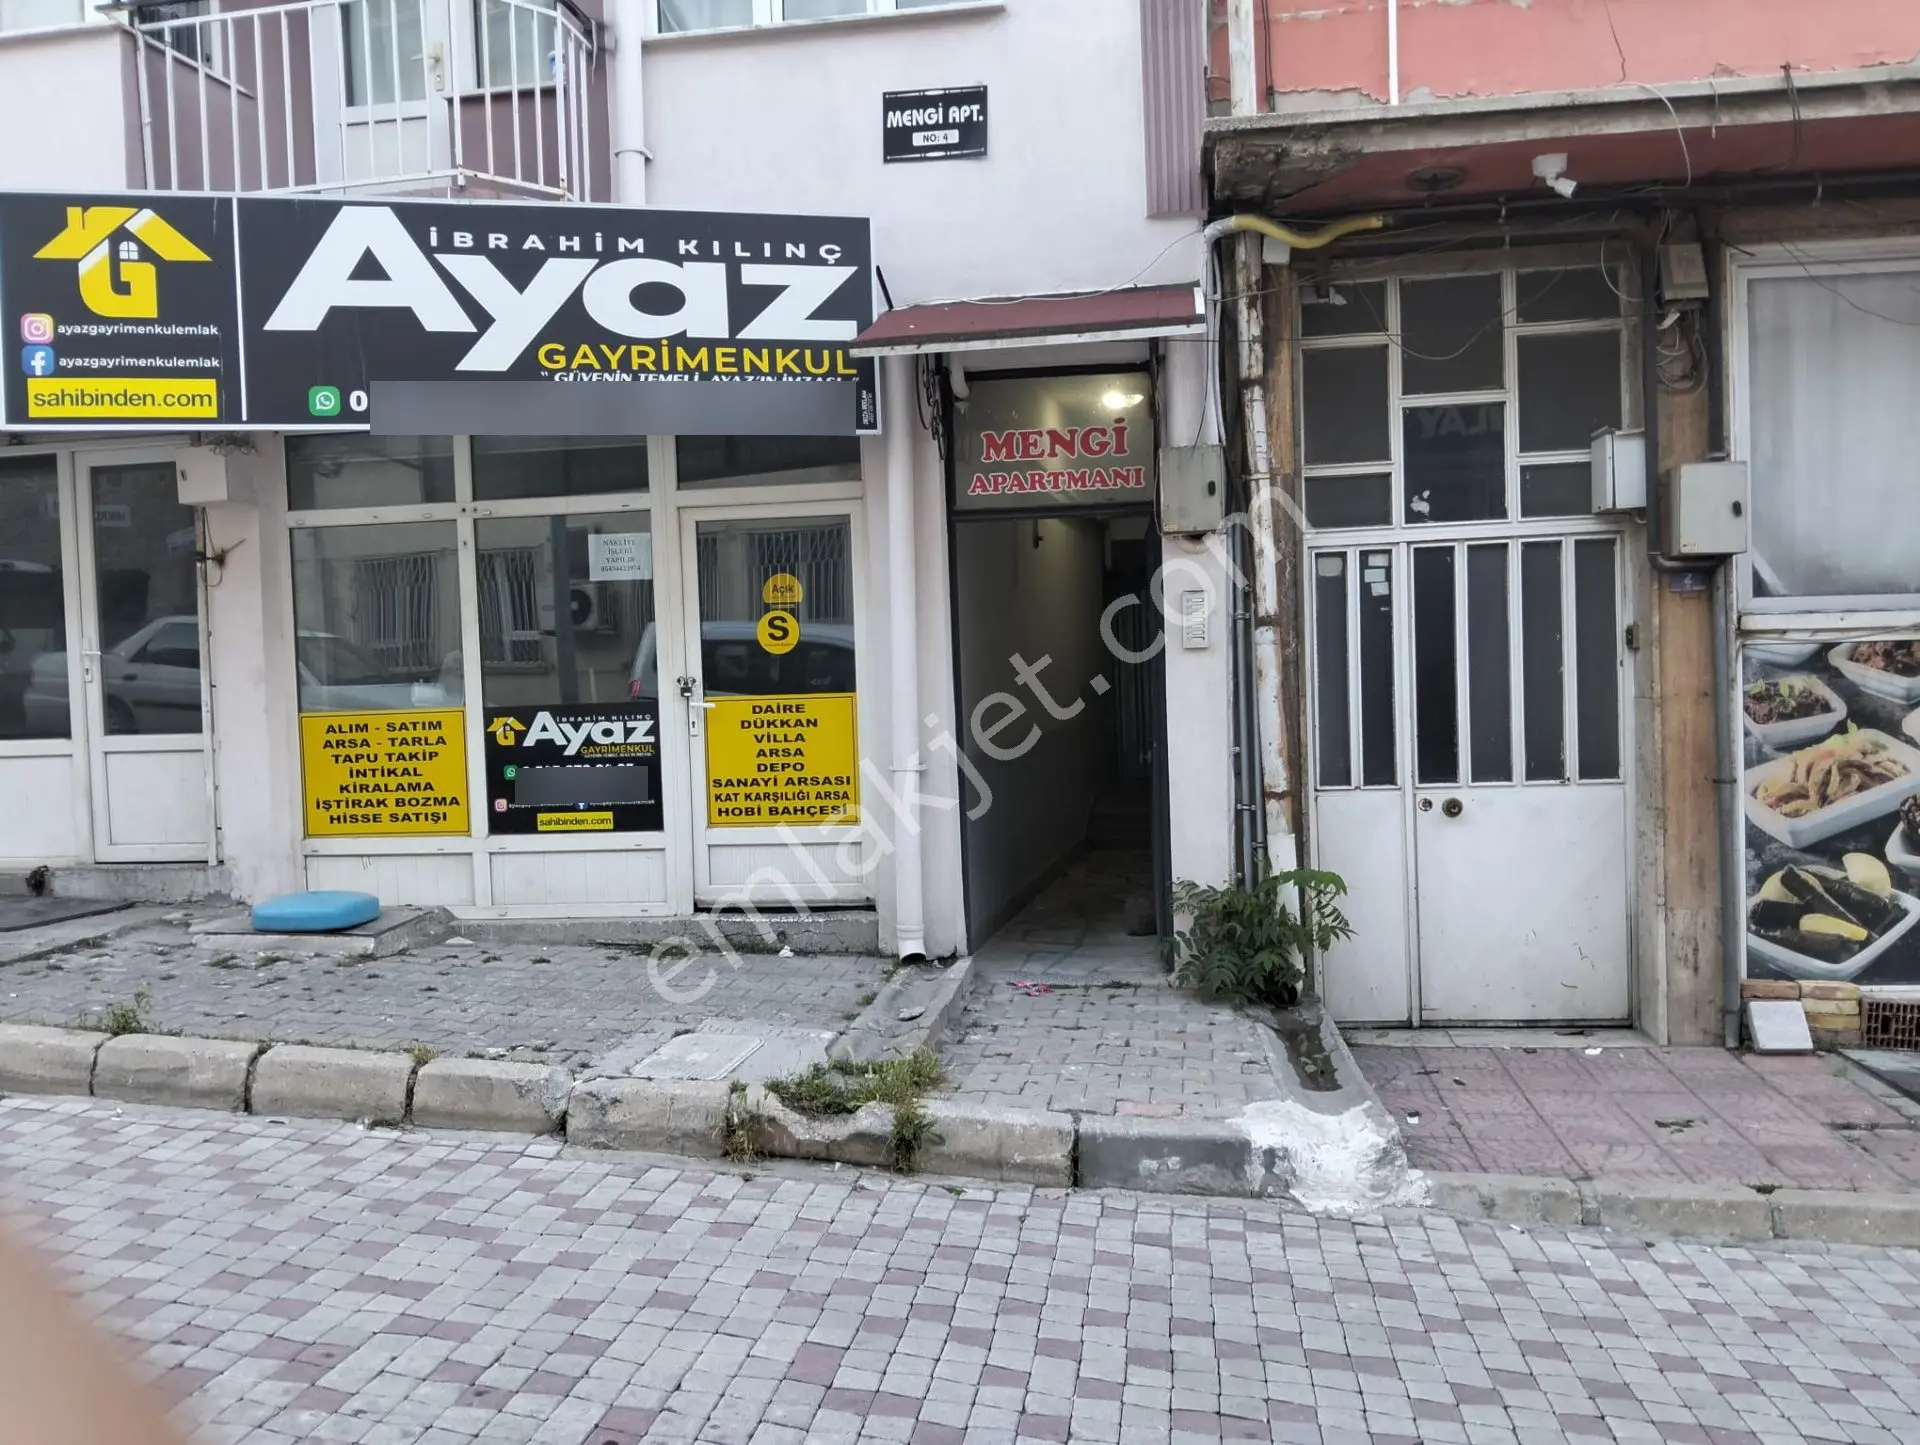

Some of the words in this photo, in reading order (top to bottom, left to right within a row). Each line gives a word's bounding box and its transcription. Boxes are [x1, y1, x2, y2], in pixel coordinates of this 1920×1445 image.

[887, 102, 943, 128] MENGİ
[948, 104, 983, 124] APT.
[430, 226, 644, 254] İBRAHİM
[679, 238, 842, 264] KILINÇ
[263, 205, 858, 372] Ayaz
[57, 322, 219, 336] ayazgayrimenkulemlak
[58, 354, 220, 368] ayazgayrimenkulemlak
[537, 338, 858, 375] GAYRİMENKUL
[33, 388, 213, 408] sahibinden.com
[981, 416, 1129, 463] MENGİ
[968, 466, 1145, 494] APARTMANI
[772, 584, 795, 596] Açık
[767, 616, 790, 642] S
[752, 702, 806, 714] DAİRE
[325, 724, 369, 734] ALIM
[386, 720, 442, 732] SATIM
[740, 718, 818, 730] DÜKKAN
[522, 711, 656, 756] Ayaz
[754, 732, 806, 744] VİLLA
[323, 738, 371, 749] ARSA
[388, 736, 447, 748] TARLA
[580, 744, 654, 754] GAYRİMENKUL
[332, 754, 378, 764] TAPU
[384, 750, 439, 762] TAKİP
[756, 748, 804, 758] ARSA
[349, 766, 423, 778] İNTİKAL
[756, 762, 805, 773] DEPO
[339, 782, 435, 794] KİRALAMA
[712, 775, 778, 788] SANAYİ
[784, 776, 850, 786] ARSASI
[714, 792, 740, 802] KAT
[744, 790, 810, 803] KARŞILIĞI
[814, 790, 850, 801] ARSA
[316, 797, 388, 812] İŞTİRAK
[395, 796, 460, 808] BOZMA
[718, 806, 762, 817] HOBİ
[768, 803, 848, 818] BAHÇESİ
[329, 812, 382, 824] HİSSE
[389, 812, 448, 824] SATIŞI
[538, 816, 612, 827] sahibinden.com
